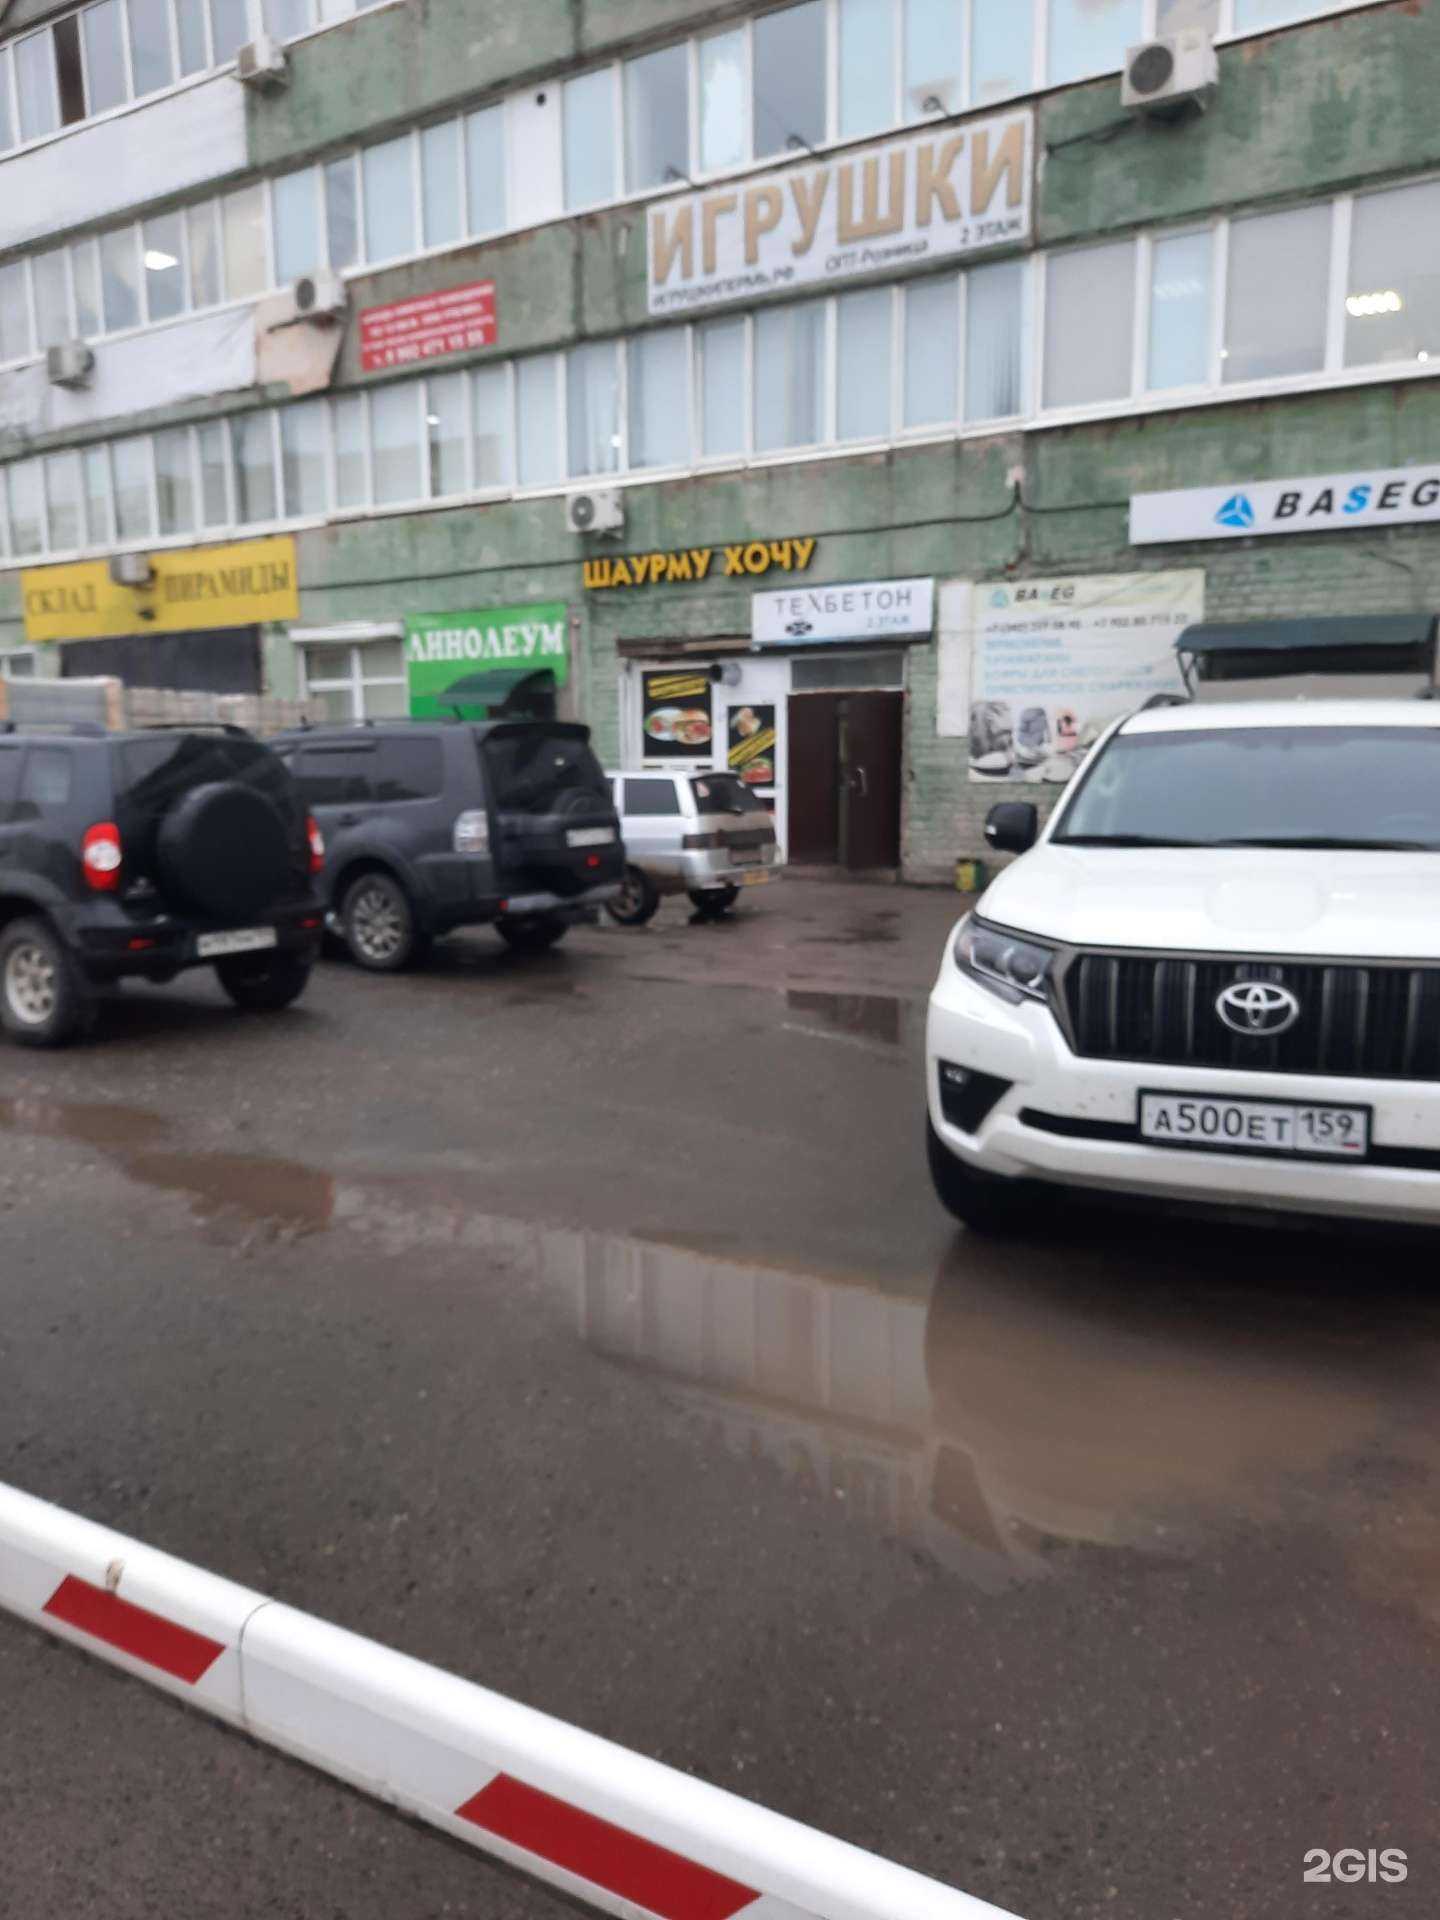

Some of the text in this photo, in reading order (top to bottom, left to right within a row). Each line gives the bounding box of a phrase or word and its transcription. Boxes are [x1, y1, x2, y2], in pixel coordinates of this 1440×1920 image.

[652, 122, 1025, 286] ИГРУШКИ
[960, 216, 1023, 246] 2 ЭТАЖ
[1272, 478, 1440, 520] BASEG
[582, 537, 816, 589] ШАУРМУ ХОЧУ
[27, 561, 291, 616] СКЛАД ПИРАМИДЫ
[1014, 584, 1076, 602] BAEG
[405, 621, 564, 661] ЛИНОЛЕУМ
[1301, 1110, 1354, 1138] 159
